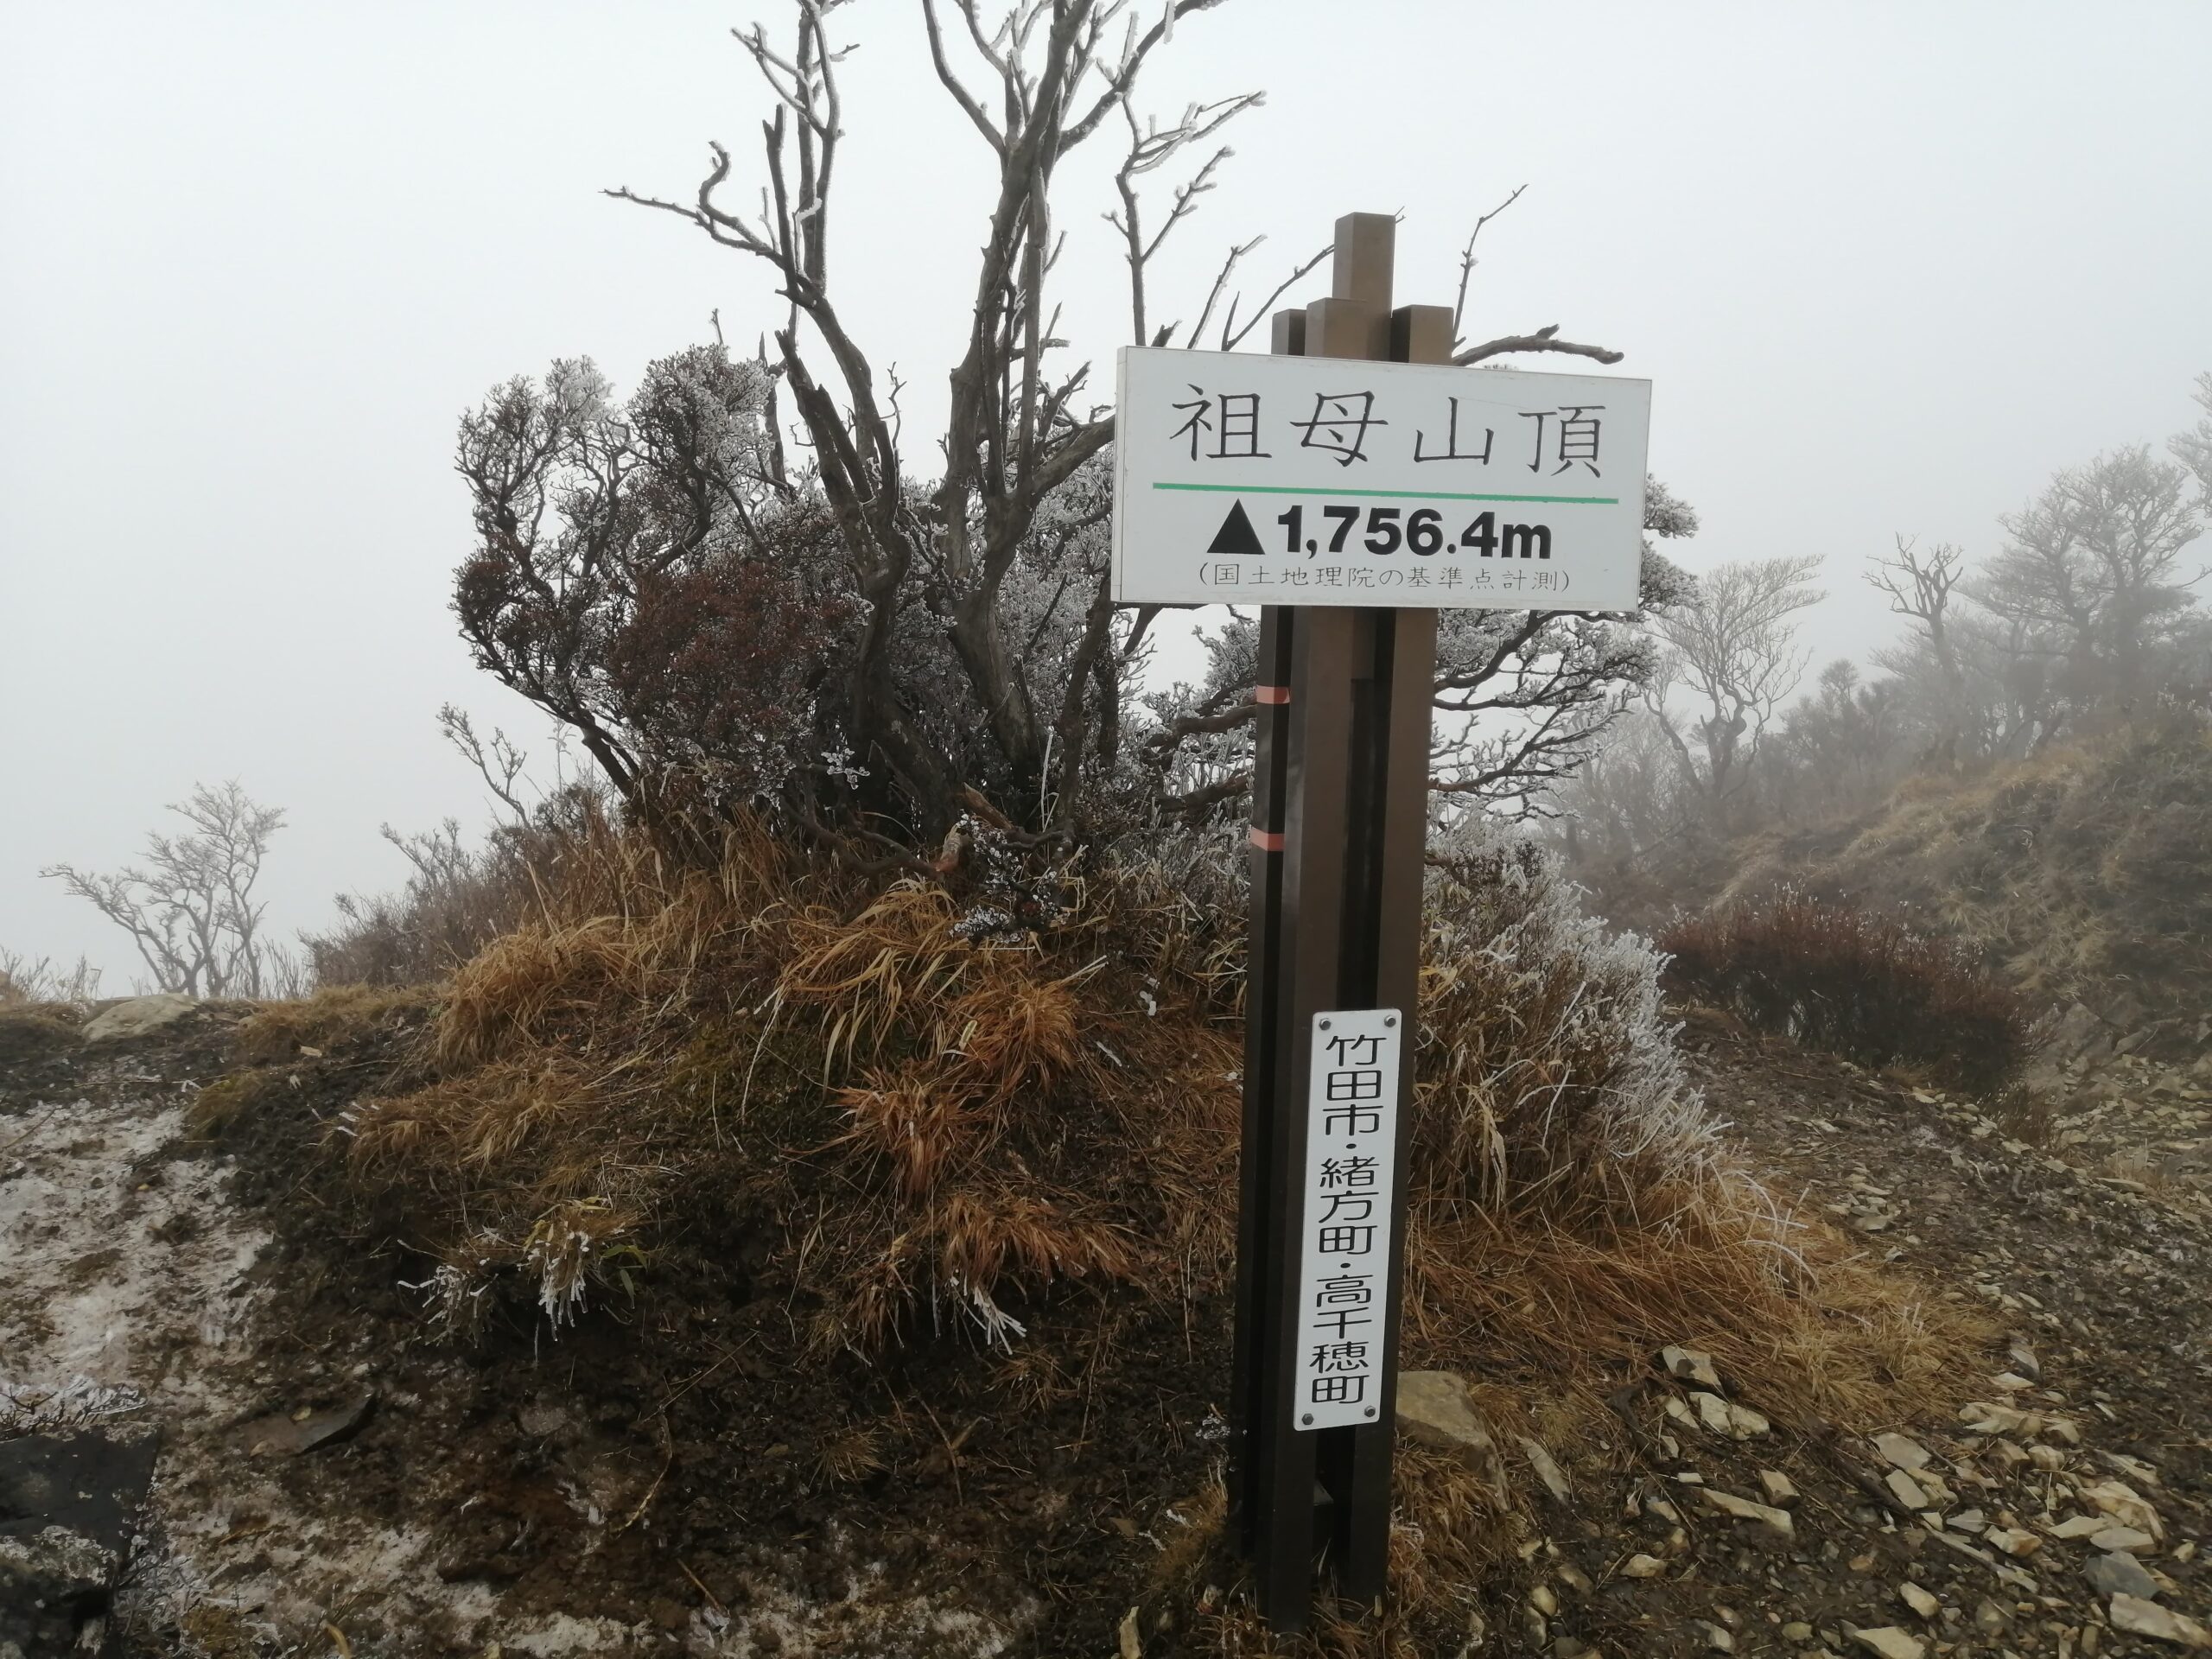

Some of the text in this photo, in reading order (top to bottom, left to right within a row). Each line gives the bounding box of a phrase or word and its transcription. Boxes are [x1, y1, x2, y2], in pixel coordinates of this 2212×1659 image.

[1170, 383, 1606, 479] 祖母山頂
[1277, 504, 1553, 560] 1,756.4m
